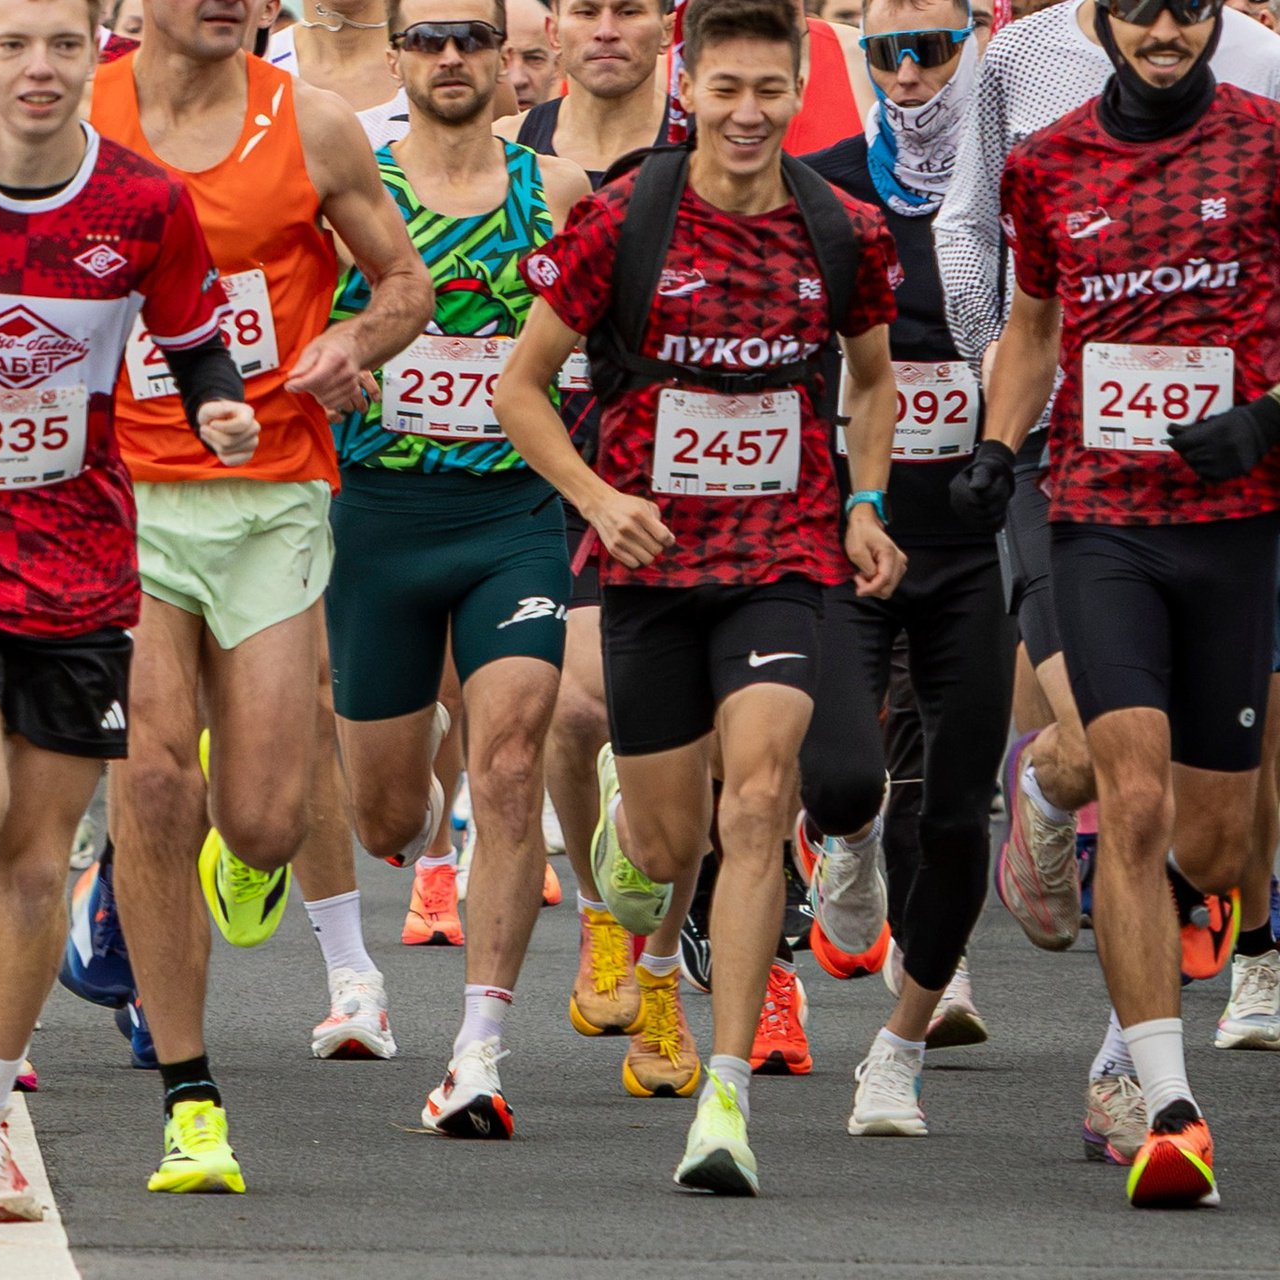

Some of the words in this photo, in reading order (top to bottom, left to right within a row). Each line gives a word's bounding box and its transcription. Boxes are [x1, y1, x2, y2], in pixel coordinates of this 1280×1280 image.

[1080, 258, 1240, 303] ЛУКОЙЛ
[137, 309, 263, 366] 28
[896, 389, 969, 425] 92
[1099, 380, 1220, 420] 2487
[673, 428, 789, 466] 2457
